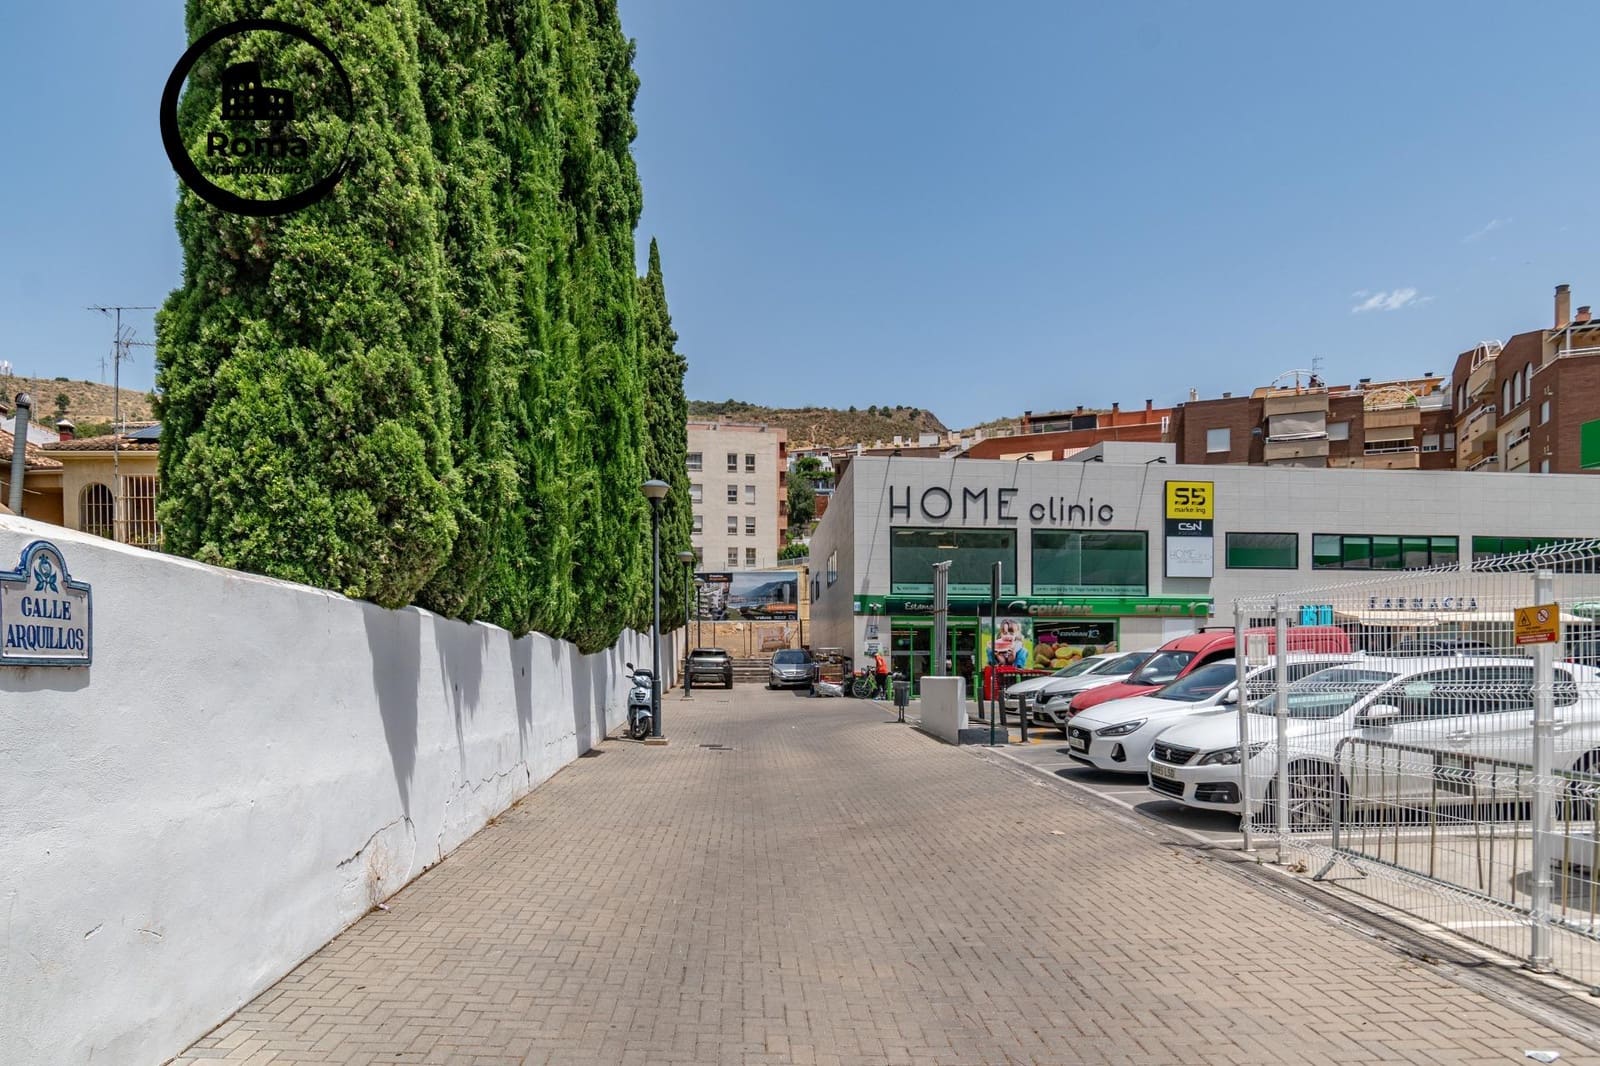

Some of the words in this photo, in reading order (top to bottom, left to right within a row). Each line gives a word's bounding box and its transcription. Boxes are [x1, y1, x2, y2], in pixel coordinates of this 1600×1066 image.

[889, 485, 1019, 520] HOME
[1029, 497, 1114, 521] clinic
[1174, 507, 1206, 515] markeing
[1178, 520, 1202, 531] CSN
[21, 596, 72, 620] CALLE
[1368, 596, 1478, 609] FARMACIA
[5, 623, 84, 651] ARQUILLOS
